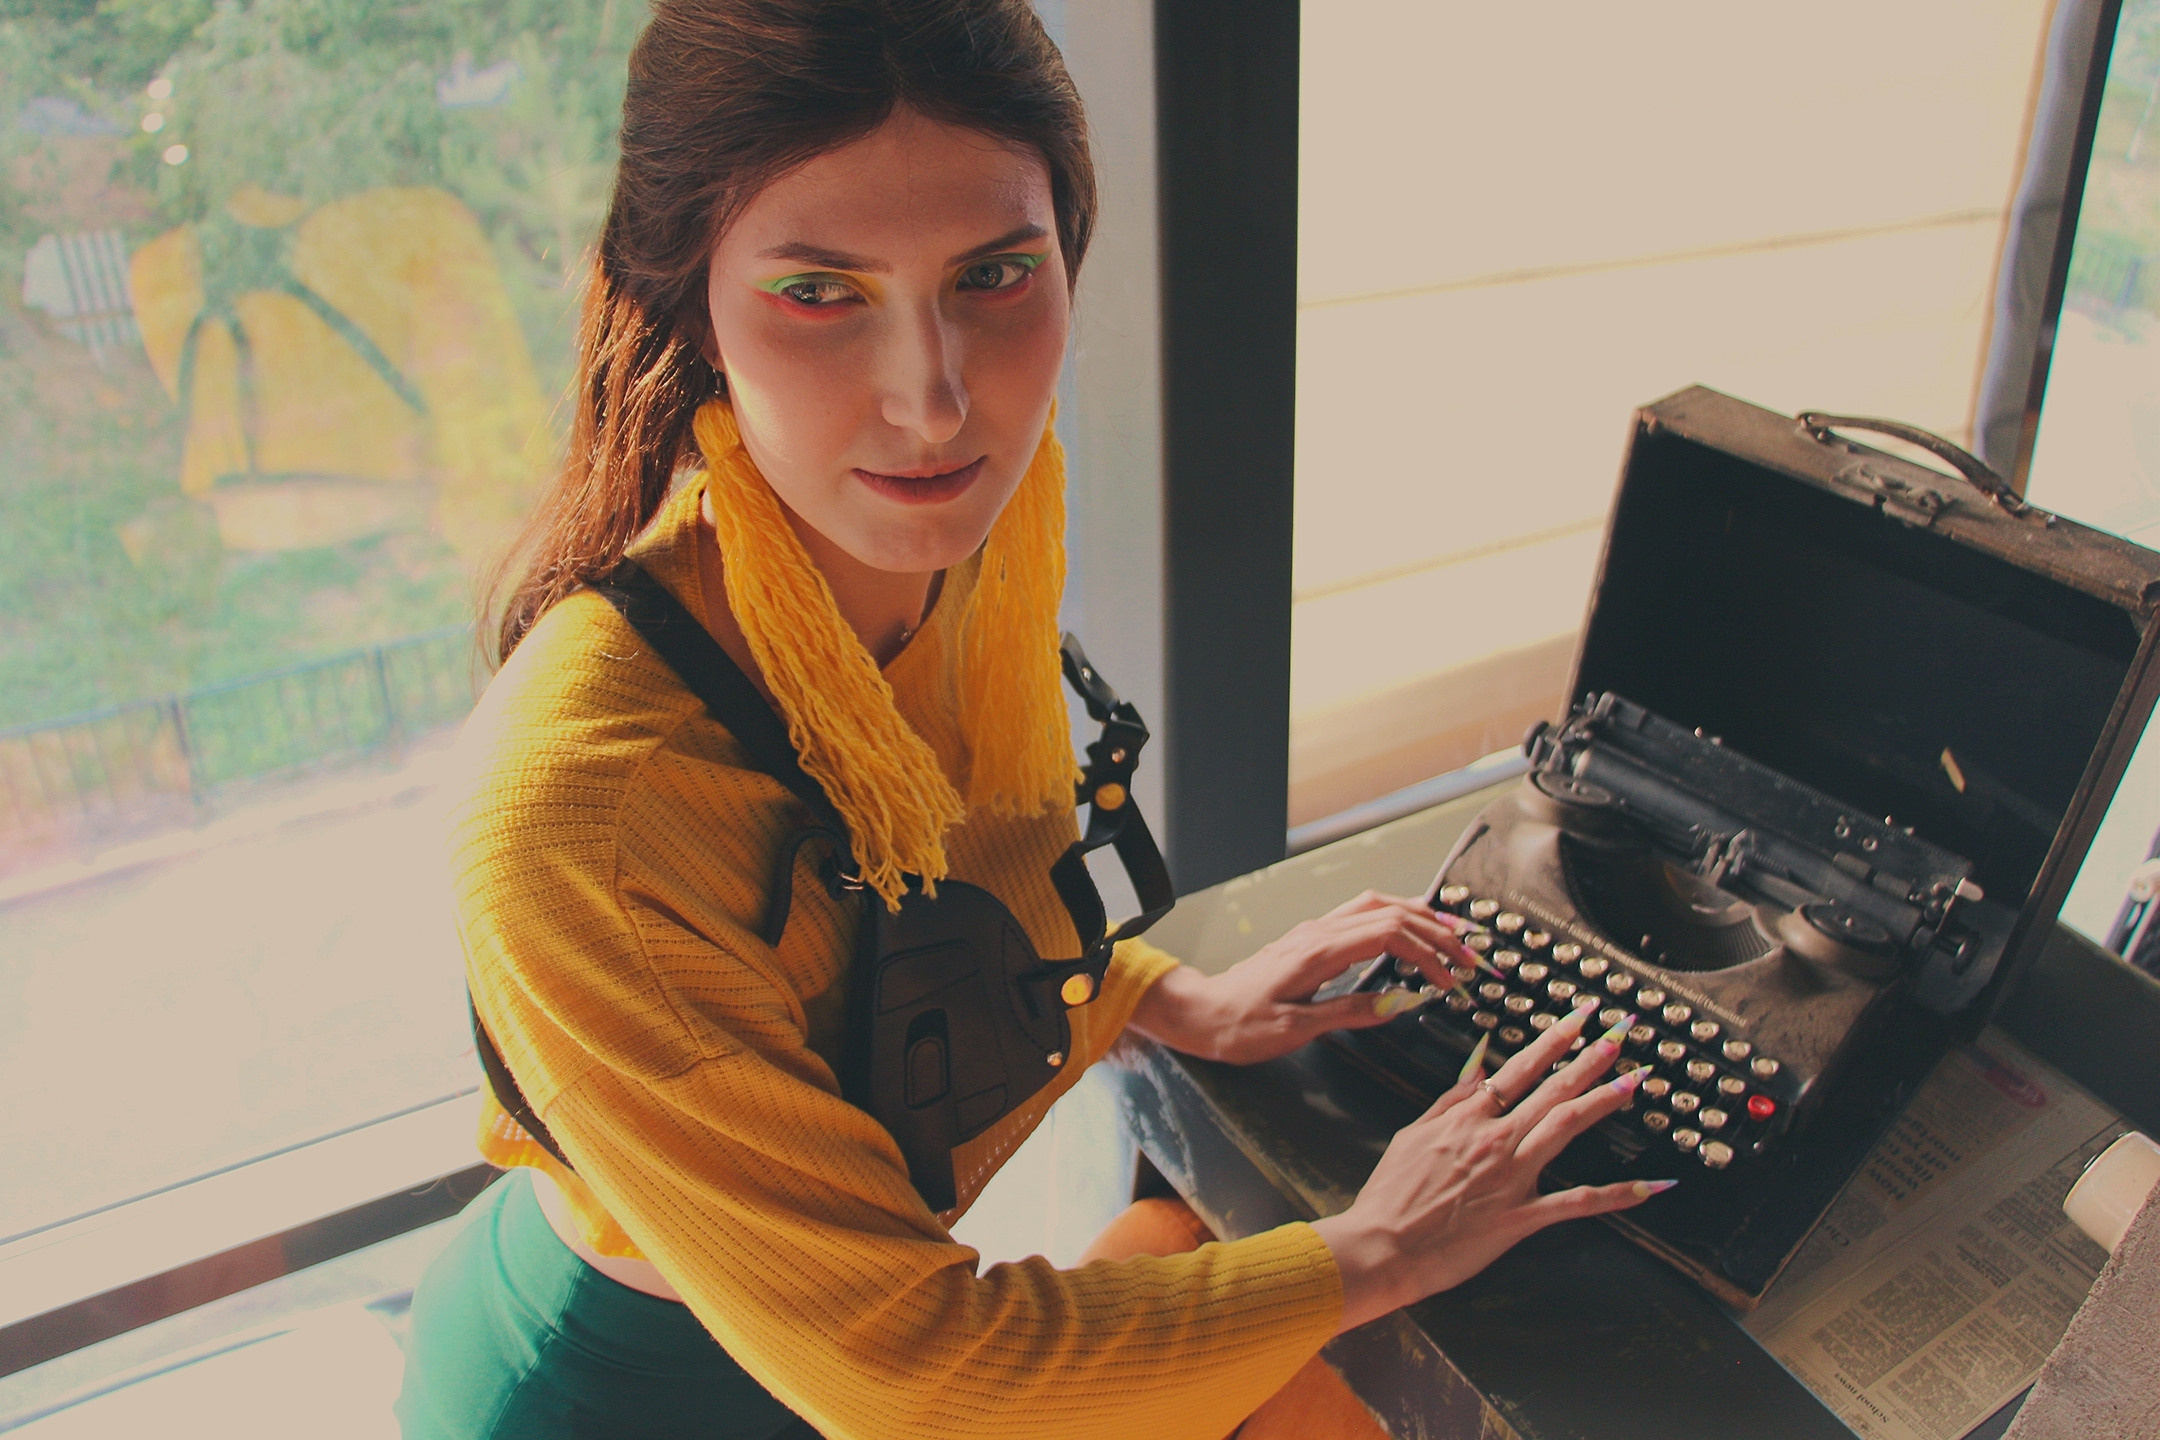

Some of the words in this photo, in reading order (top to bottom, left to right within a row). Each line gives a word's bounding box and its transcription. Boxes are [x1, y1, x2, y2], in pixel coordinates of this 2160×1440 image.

[1901, 1153, 1934, 1183] like
[1867, 1167, 1906, 1201] How
[1833, 1372, 1858, 1395] news
[1855, 1393, 1890, 1424] School
